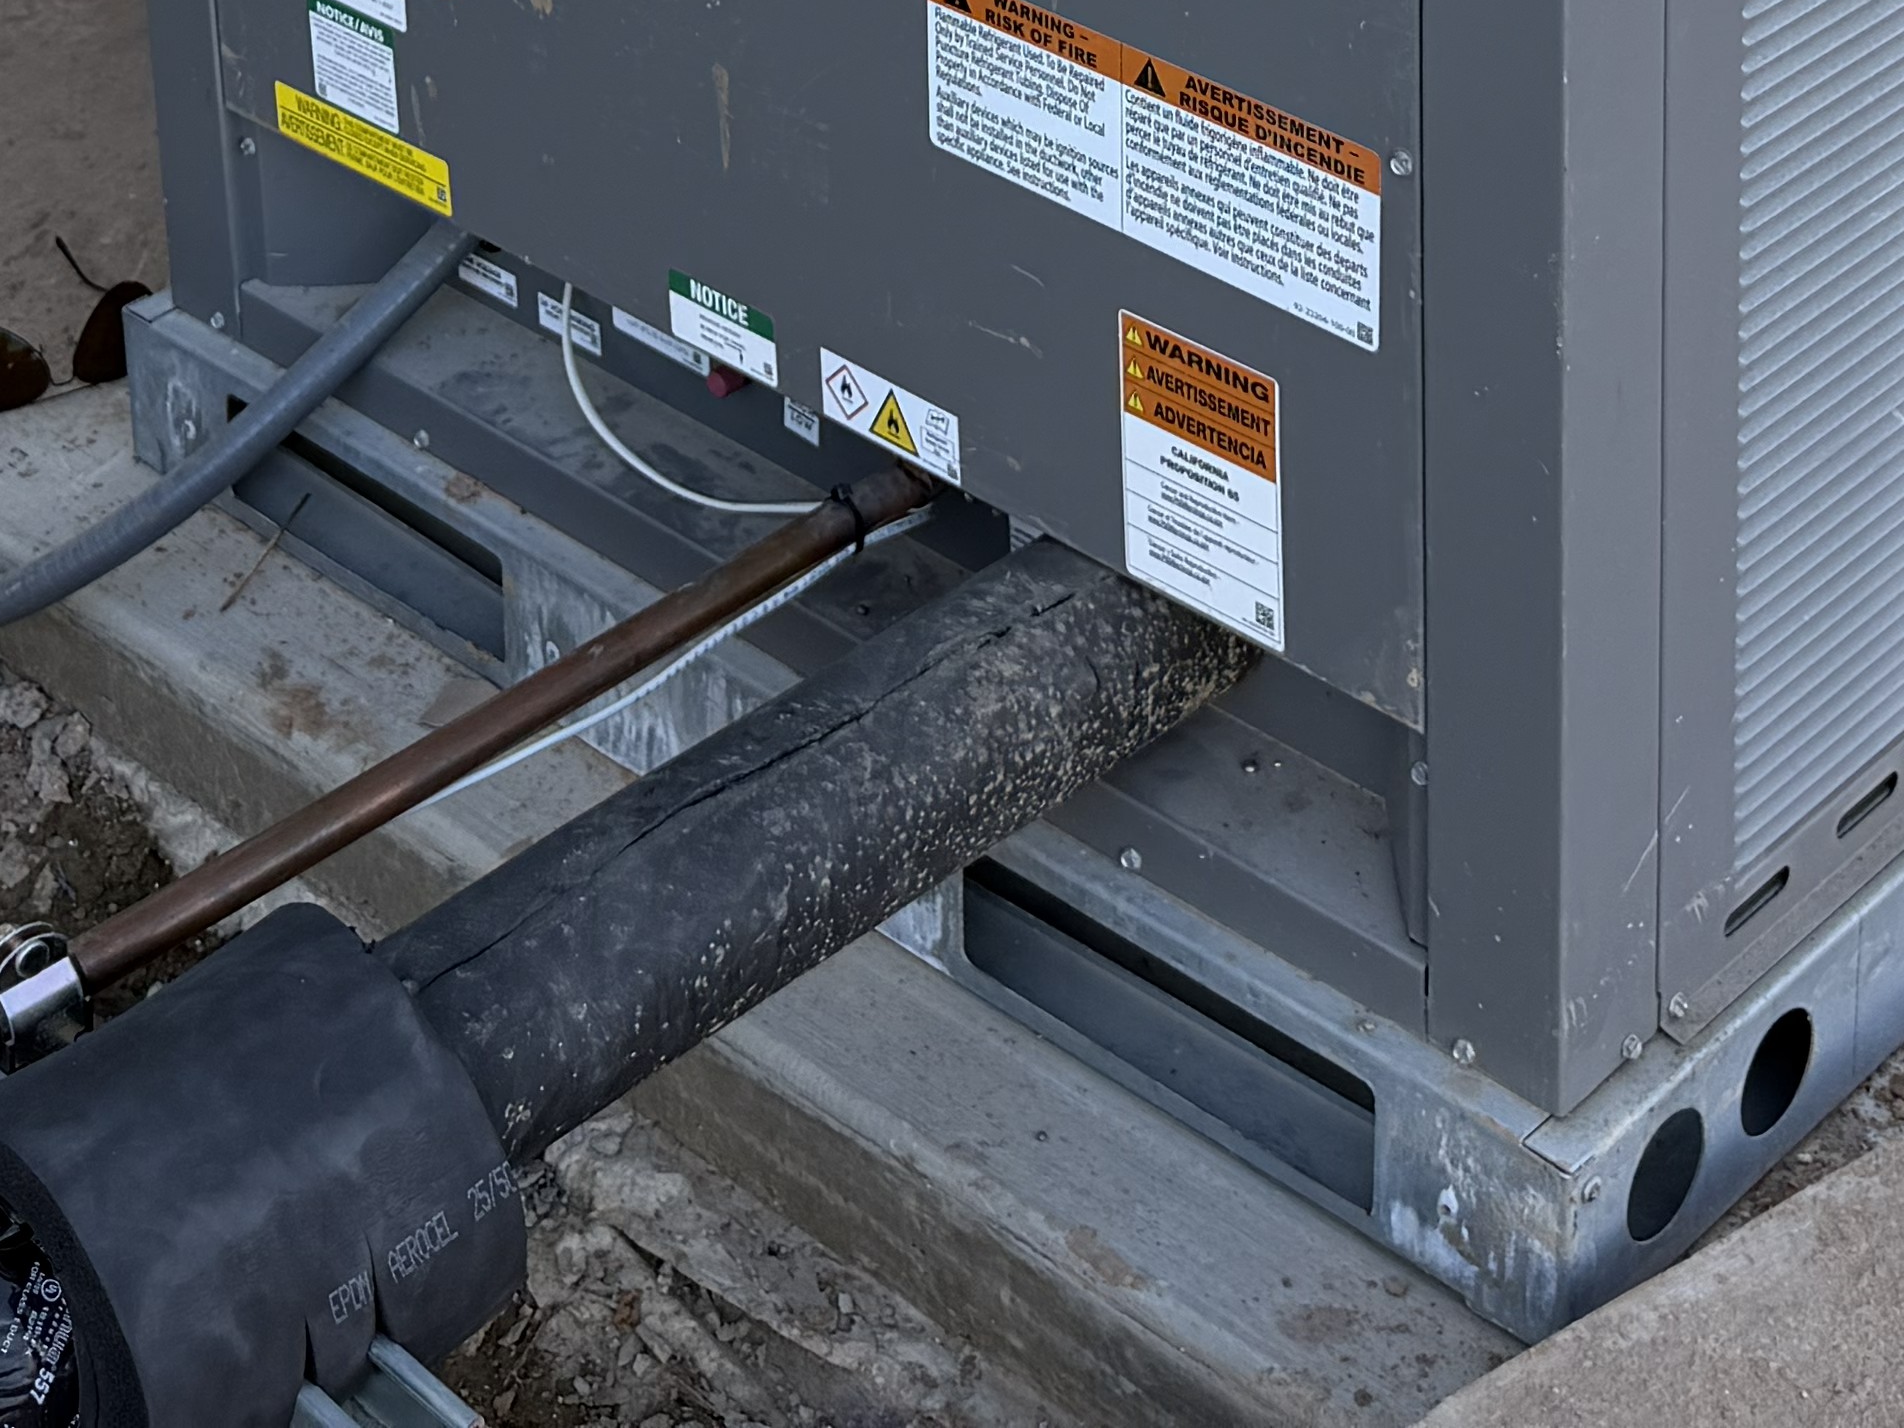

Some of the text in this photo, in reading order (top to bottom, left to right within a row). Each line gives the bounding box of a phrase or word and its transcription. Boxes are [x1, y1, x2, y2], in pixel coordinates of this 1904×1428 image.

[985, 7, 1096, 68] RISK OF FIRE
[1179, 90, 1364, 186] RISQUE D'INCENDIE
[1185, 73, 1344, 156] AVERTISSEMENT
[689, 279, 750, 326] NOTICE
[1145, 329, 1269, 404] WARNING
[1146, 363, 1271, 438] AVERTISSEMENT
[1153, 399, 1266, 470] ADVERTENCIA
[1171, 444, 1228, 481] CALIFORNIA
[1160, 454, 1239, 503] PROPOSITION 65
[328, 1270, 374, 1325] EPDM
[388, 1211, 459, 1283] AEROCEL
[30, 1367, 56, 1406] 557
